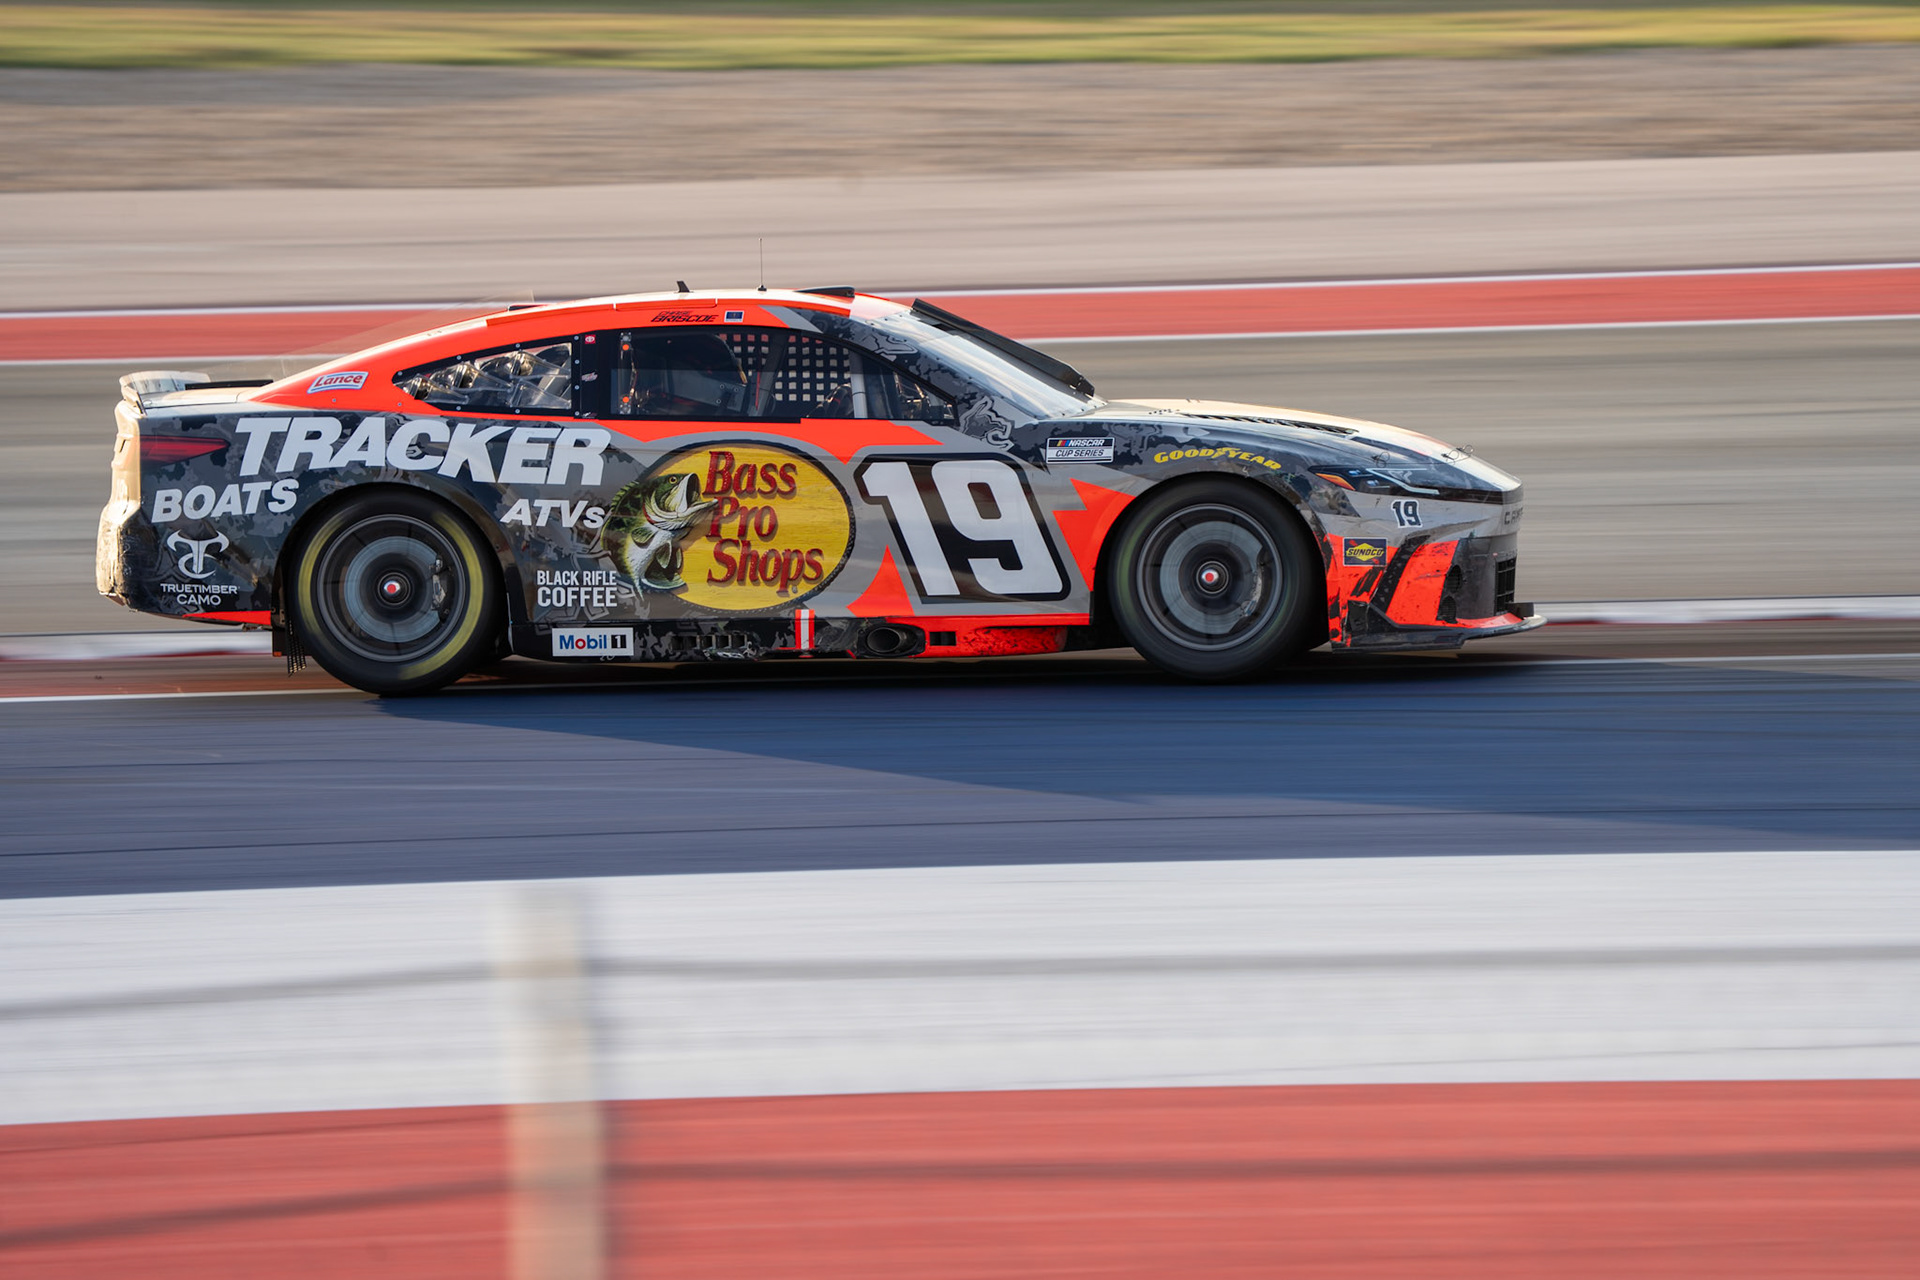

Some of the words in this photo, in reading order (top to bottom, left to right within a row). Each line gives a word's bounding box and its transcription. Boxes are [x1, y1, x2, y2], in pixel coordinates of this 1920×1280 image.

[651, 314, 719, 323] BRISCOE
[313, 374, 363, 388] Lance
[235, 416, 611, 486] TRACKER
[1055, 449, 1072, 457] CUP
[1073, 448, 1104, 457] SERIES
[1068, 438, 1105, 447] NASCAR
[1153, 447, 1282, 471] GOODYEAR
[702, 450, 798, 496] Bass
[151, 478, 300, 524] BOATS
[500, 498, 605, 528] ATVs
[705, 496, 778, 540] Pro
[1392, 500, 1422, 527] 19
[861, 459, 1063, 596] 19
[1347, 548, 1384, 556] SUNOCO
[707, 538, 824, 595] Shops
[536, 570, 580, 586] BLACK
[582, 570, 617, 586] RIFLE
[160, 583, 238, 595] TRUETIMBER
[537, 586, 618, 607] COFFEE
[176, 594, 222, 606] CAMO
[559, 634, 608, 650] Mobil
